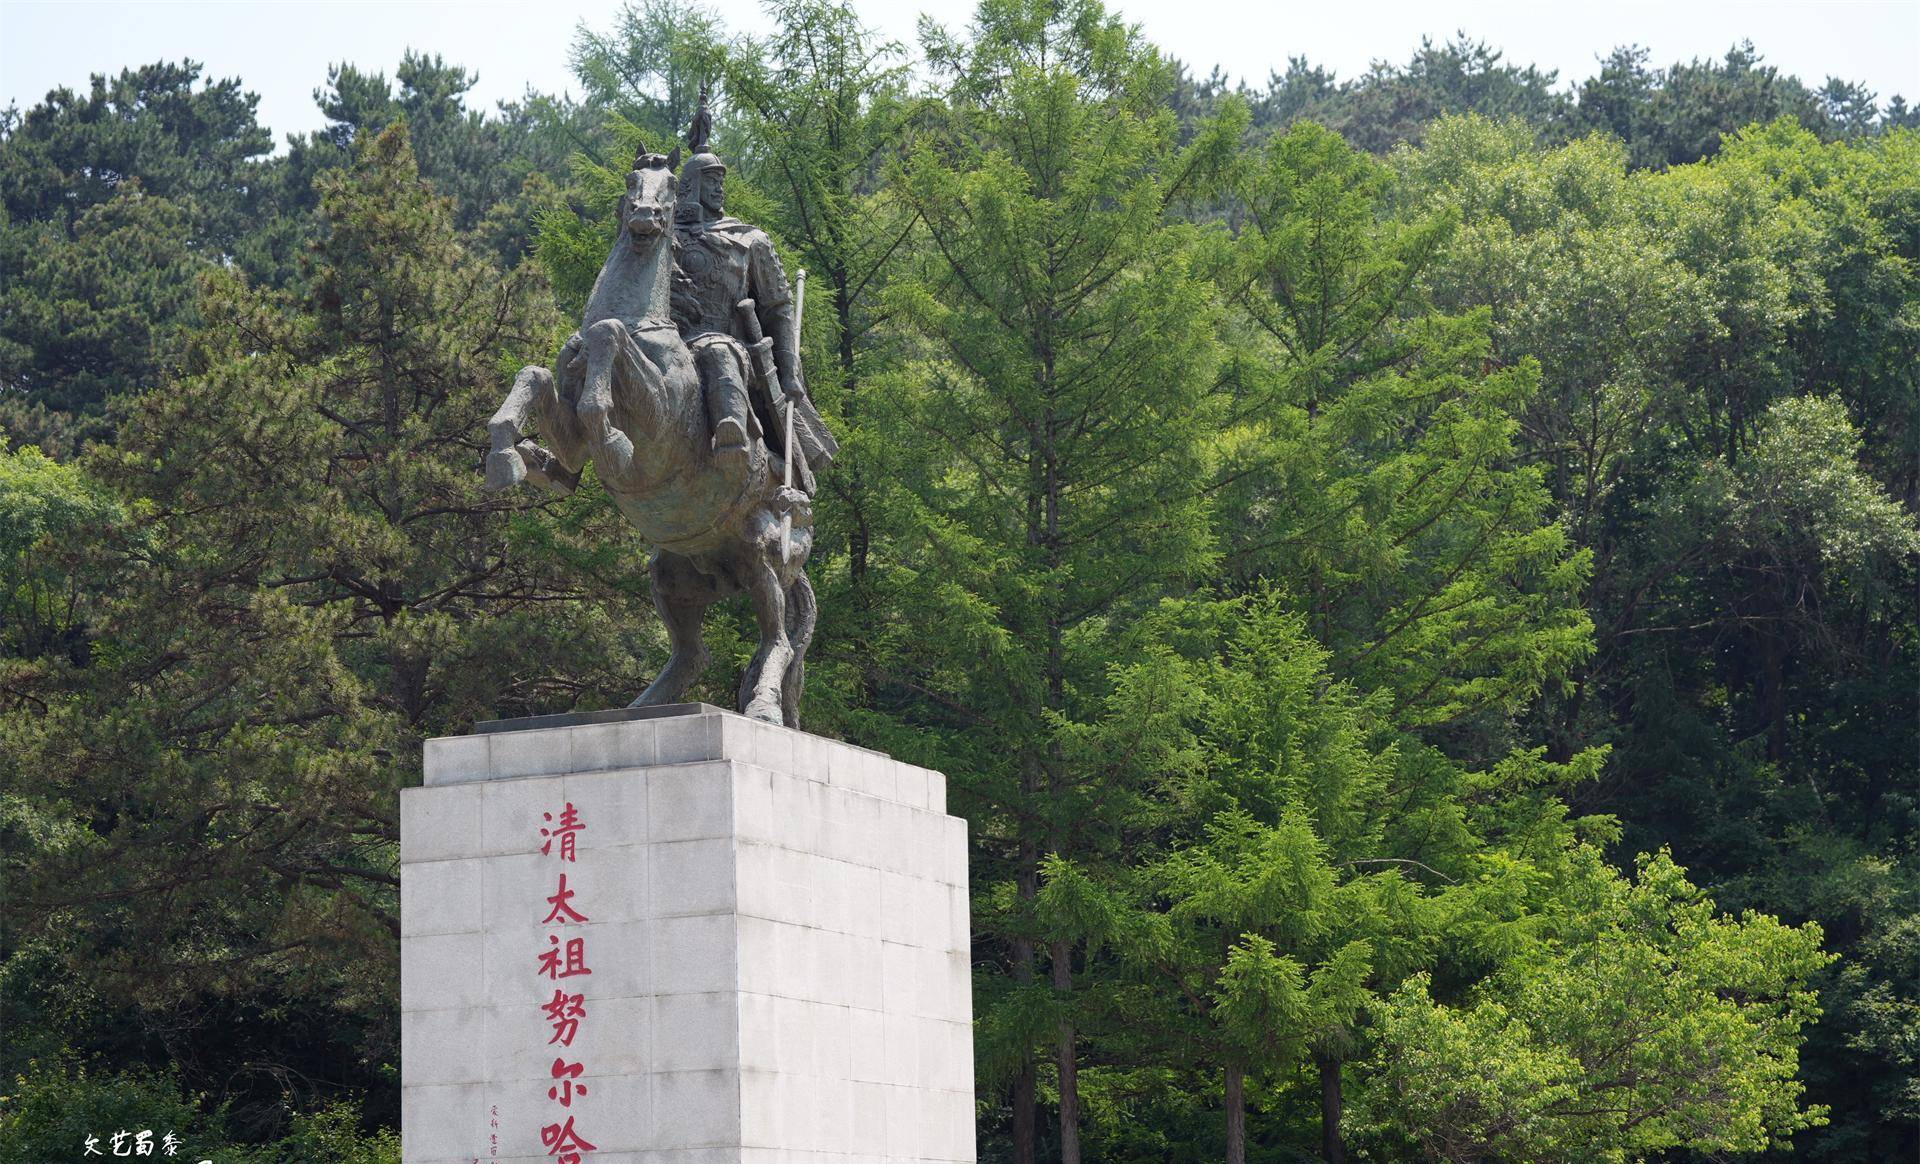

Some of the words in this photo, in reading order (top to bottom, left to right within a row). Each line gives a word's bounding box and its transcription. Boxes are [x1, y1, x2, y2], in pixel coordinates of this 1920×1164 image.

[538, 802, 597, 1164] 清太祖努尔哈
